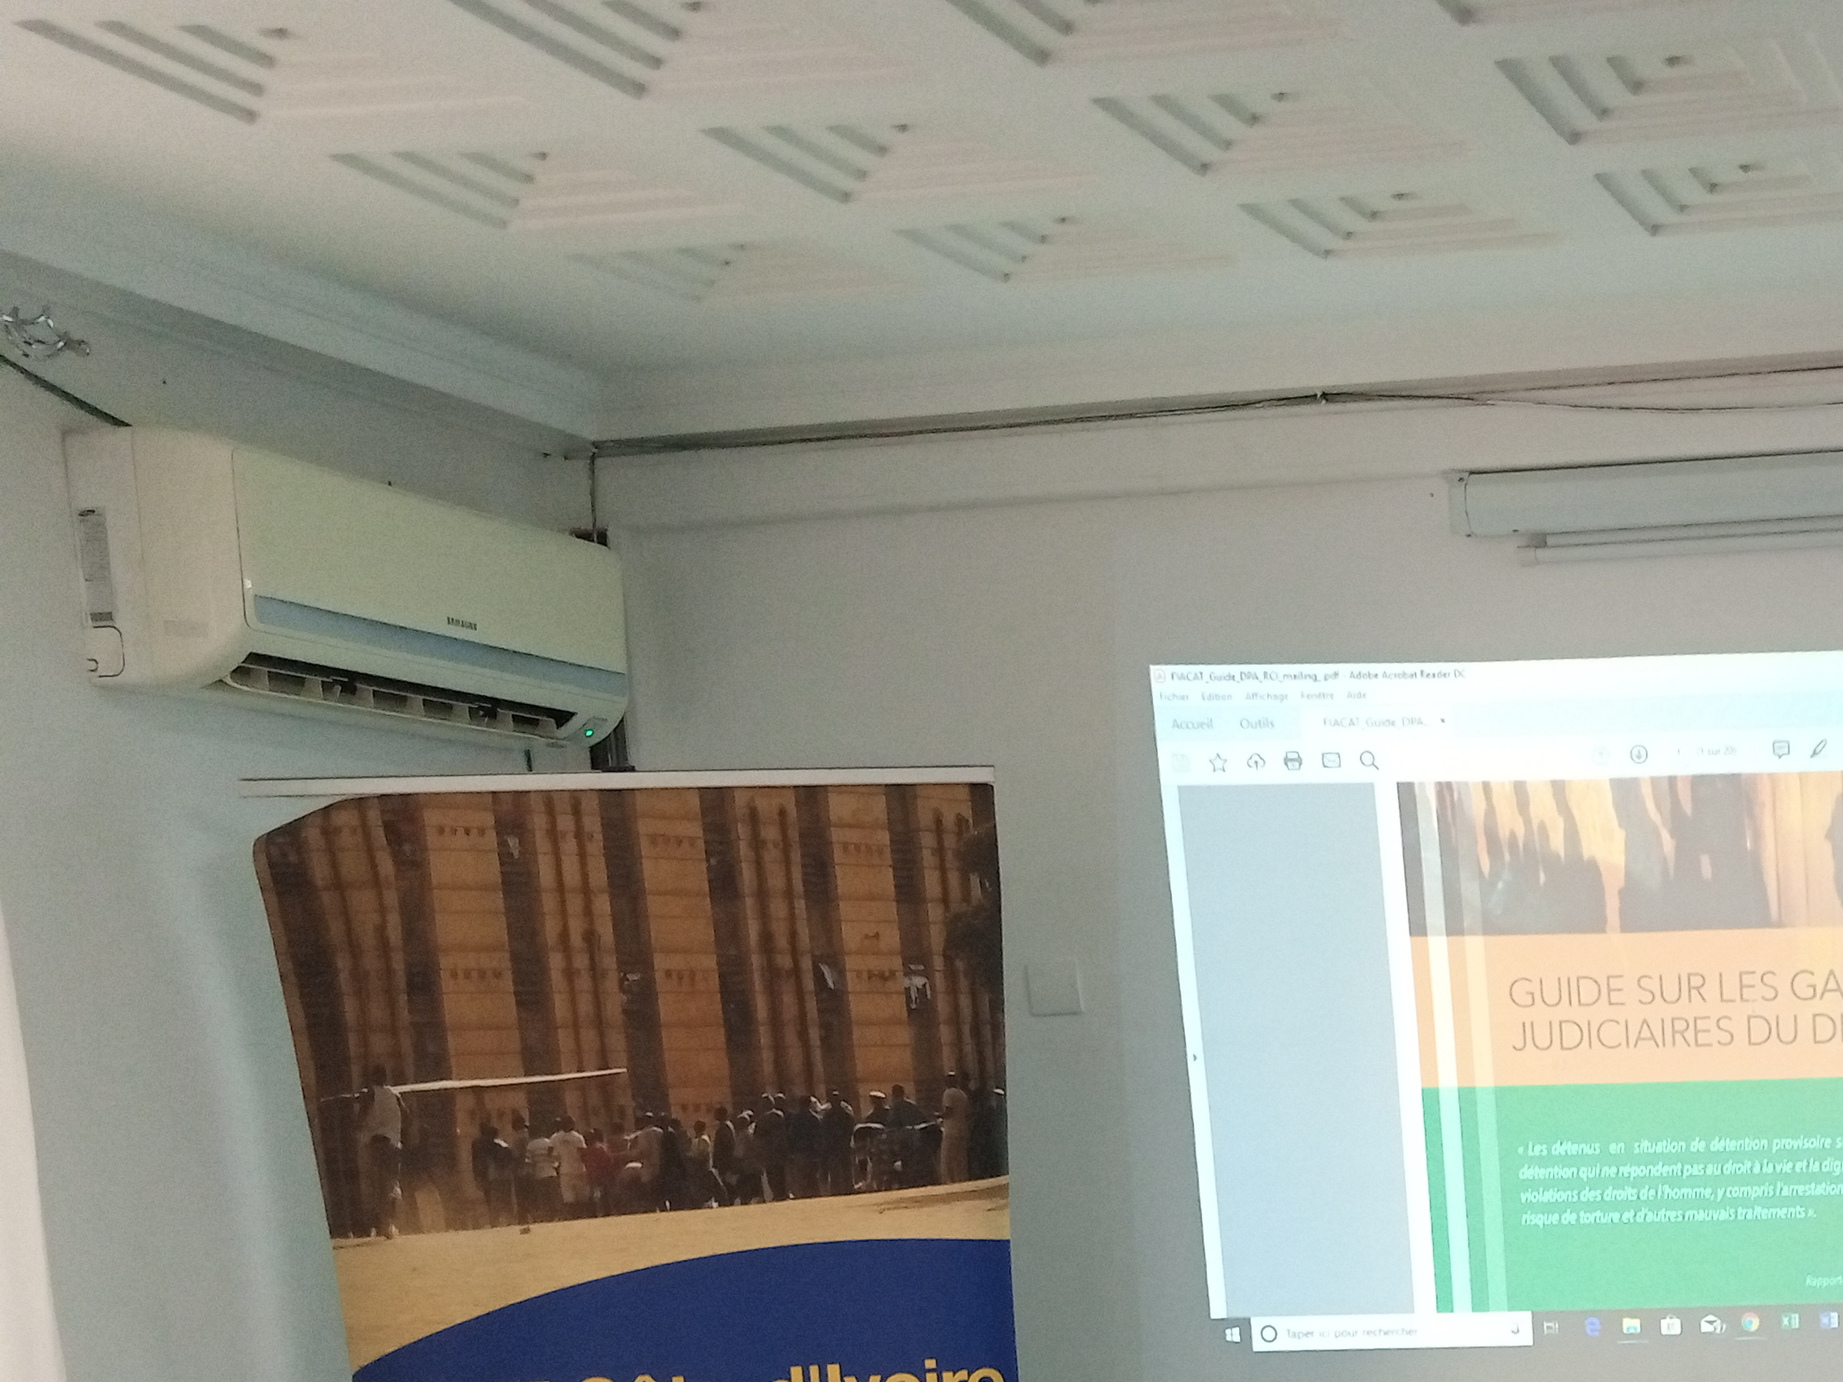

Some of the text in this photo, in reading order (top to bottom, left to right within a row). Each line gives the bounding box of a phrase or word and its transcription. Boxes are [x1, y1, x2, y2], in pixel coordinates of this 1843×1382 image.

[1171, 717, 1275, 731] Accueil Outils
[1507, 973, 1627, 1009] GUIDE
[1636, 971, 1707, 1006] SUR
[1718, 969, 1779, 1003] LES
[1511, 1015, 1735, 1052] JUDICIAIRES
[1746, 1012, 1799, 1047] DU
[1527, 1141, 1548, 1157] Les
[1551, 1138, 1601, 1156] détenus
[1608, 1141, 1626, 1155] en
[1633, 1137, 1686, 1154] situation
[1689, 1136, 1706, 1153] de
[1709, 1135, 1769, 1152] détention
[1771, 1135, 1832, 1154] provisoire
[1518, 1163, 1578, 1180] détention
[1578, 1162, 1600, 1182] qui
[1601, 1165, 1618, 1178] ne
[1618, 1160, 1682, 1181] répondent
[1683, 1163, 1705, 1179] pas
[1706, 1163, 1722, 1176] au
[1723, 1159, 1752, 1175] droit
[1752, 1160, 1761, 1174] à
[1762, 1157, 1774, 1174] la
[1775, 1157, 1793, 1173] vie
[1794, 1158, 1809, 1173] et
[1809, 1156, 1820, 1172] la
[1519, 1186, 1578, 1203] violations
[1579, 1185, 1602, 1202] des
[1602, 1185, 1638, 1202] droits
[1639, 1184, 1656, 1200] de
[1716, 1186, 1726, 1203] y
[1726, 1181, 1775, 1201] compris
[1521, 1210, 1560, 1229] risque
[1561, 1208, 1578, 1225] de
[1579, 1208, 1622, 1224] torture
[1621, 1208, 1635, 1224] et
[1684, 1206, 1737, 1222] mauvais
[1737, 1204, 1806, 1222] traitements
[1333, 1328, 1359, 1340] pour
